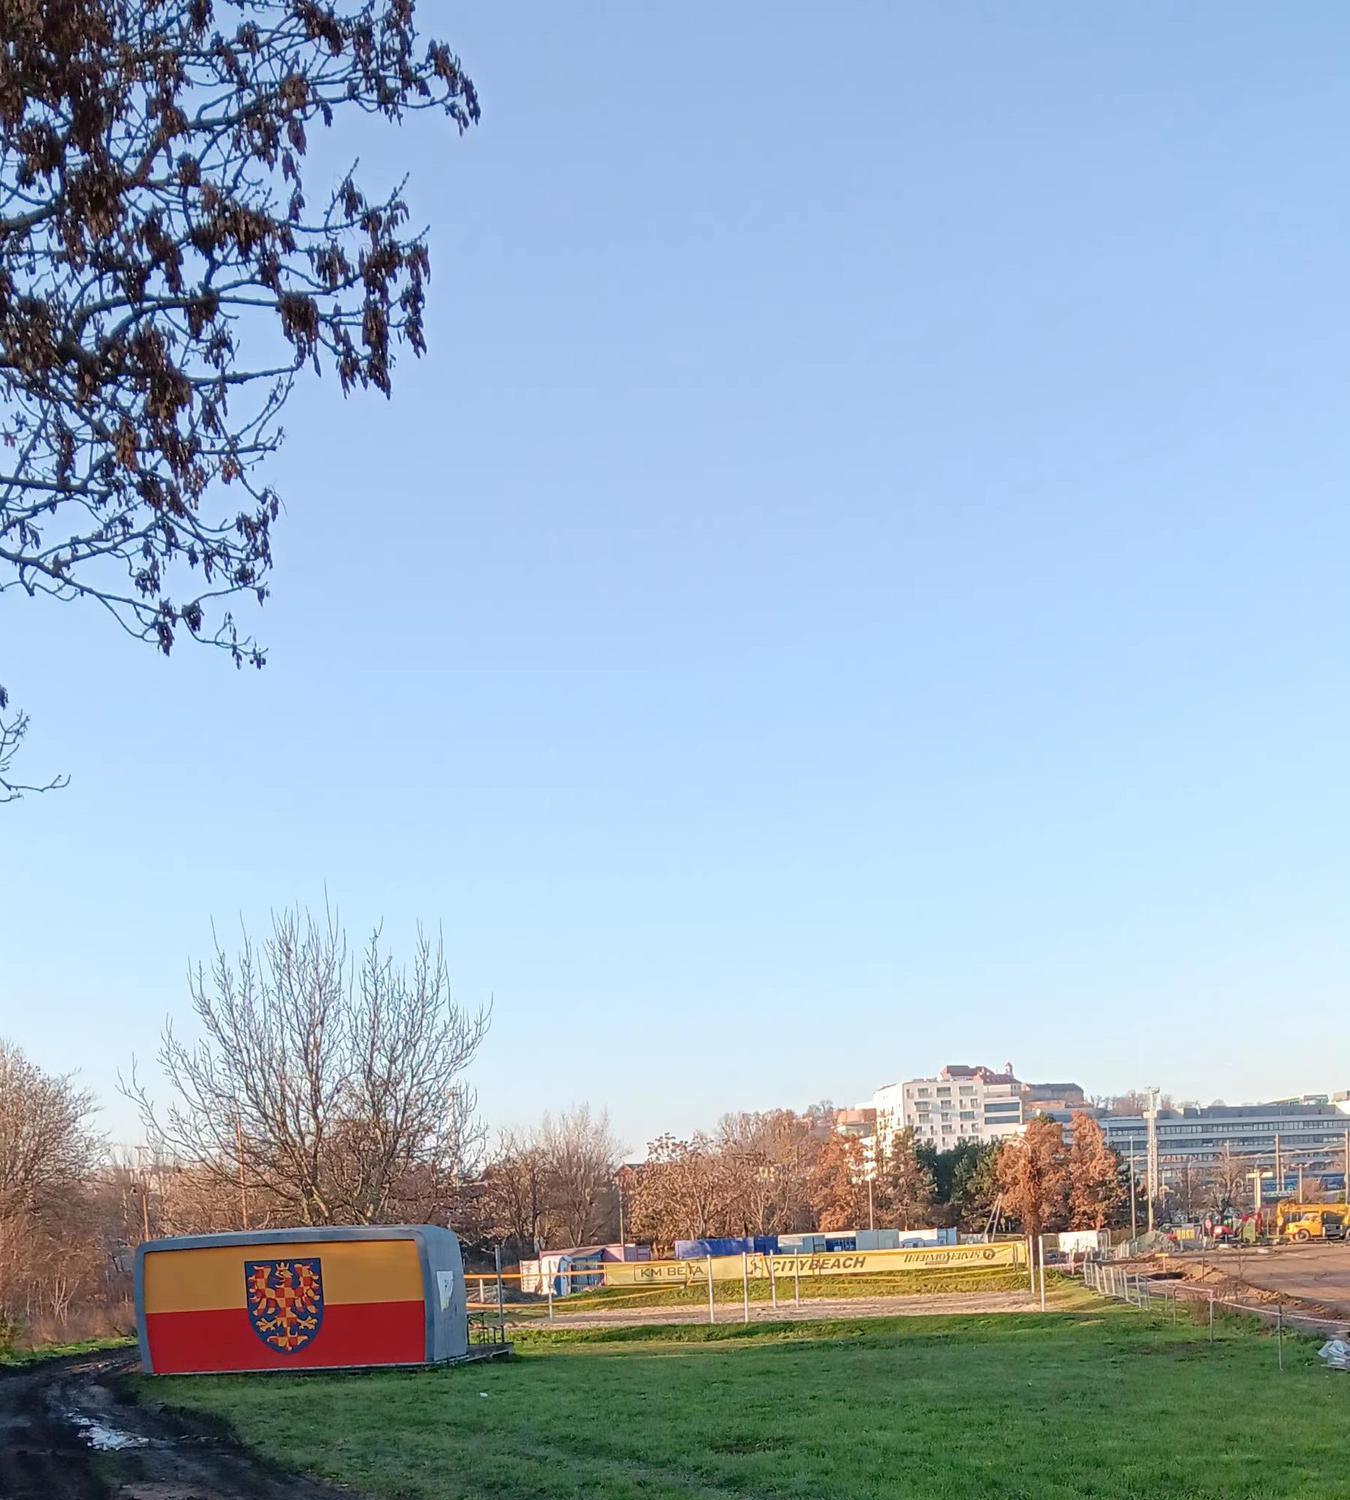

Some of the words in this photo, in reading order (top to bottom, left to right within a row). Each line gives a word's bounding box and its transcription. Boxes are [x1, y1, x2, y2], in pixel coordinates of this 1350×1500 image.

[772, 1256, 867, 1273] CITYBEACH
[640, 1267, 662, 1278] KM
[667, 1266, 704, 1277] BETA
